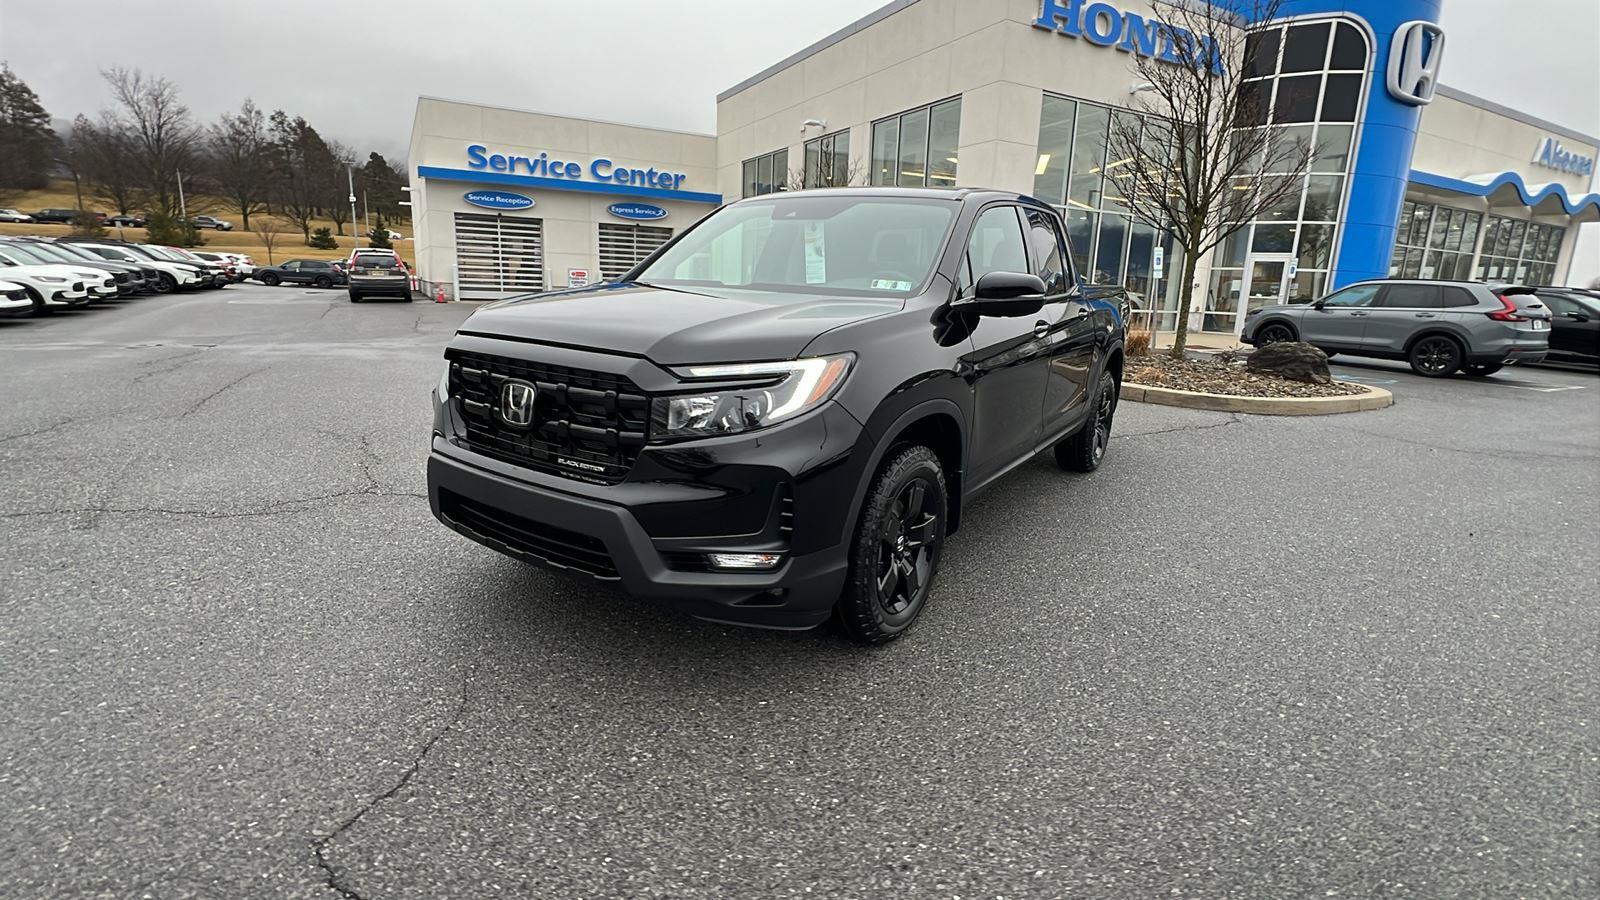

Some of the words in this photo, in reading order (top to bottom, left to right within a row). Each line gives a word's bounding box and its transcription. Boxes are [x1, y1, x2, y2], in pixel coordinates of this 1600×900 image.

[1034, 0, 1226, 77] HONDA
[467, 144, 582, 177] Service
[590, 158, 686, 190] Center
[467, 193, 495, 202] Service
[495, 196, 531, 205] Reception
[634, 207, 656, 215] Service
[557, 458, 579, 468] BLACK
[579, 462, 606, 472] EDITION
